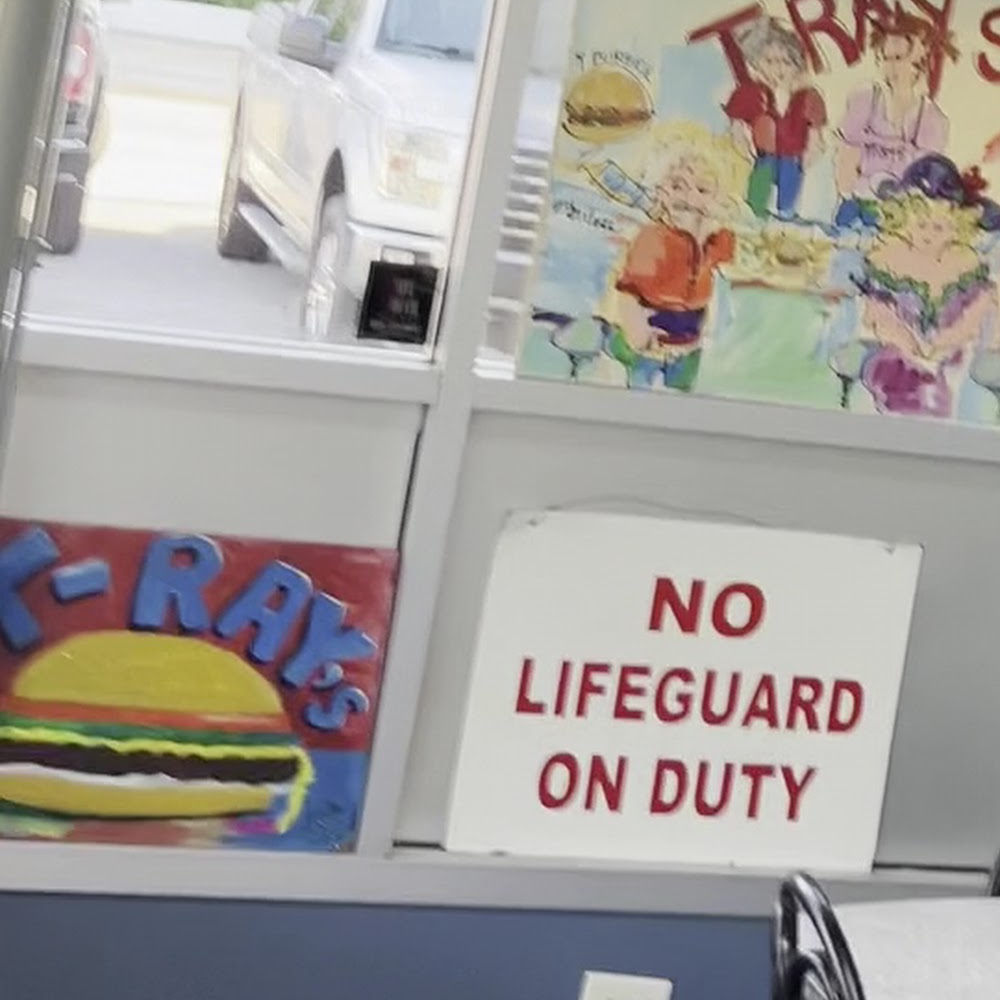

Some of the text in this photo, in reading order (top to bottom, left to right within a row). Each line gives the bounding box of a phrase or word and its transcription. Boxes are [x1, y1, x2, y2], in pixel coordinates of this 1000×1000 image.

[648, 576, 767, 638] NO
[515, 656, 866, 733] LIFEGUARD
[537, 750, 818, 823] ON DUTY
